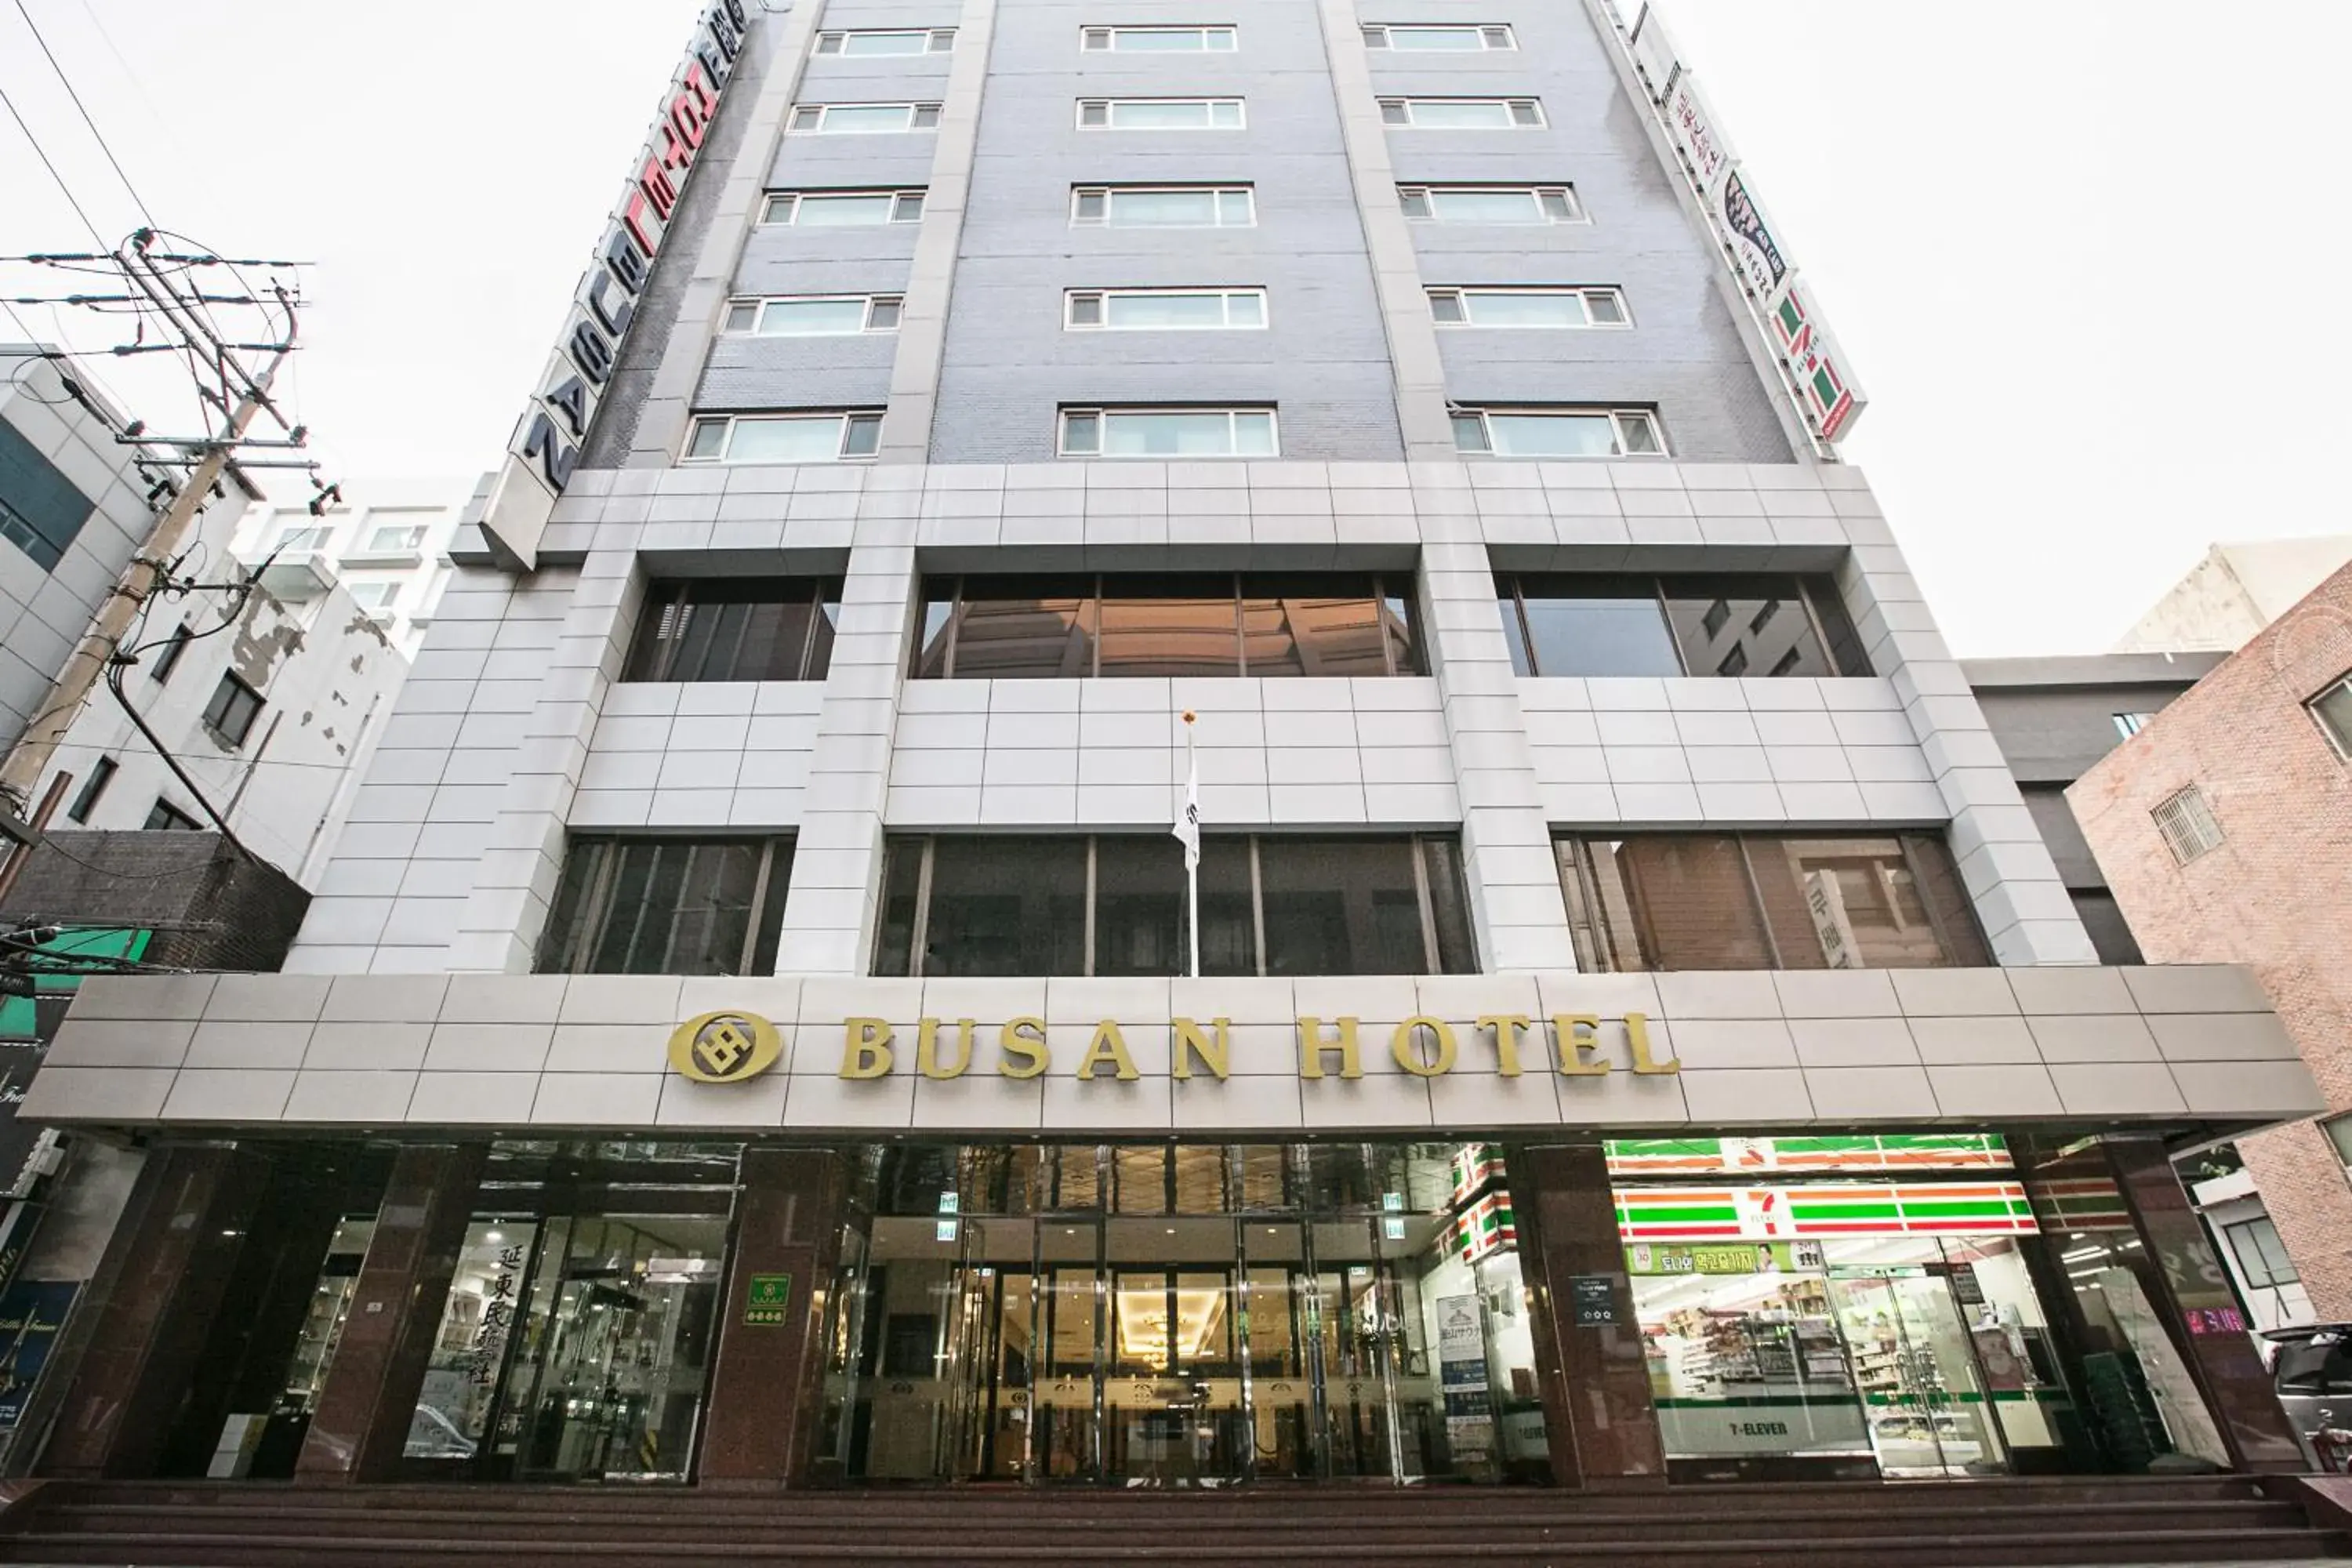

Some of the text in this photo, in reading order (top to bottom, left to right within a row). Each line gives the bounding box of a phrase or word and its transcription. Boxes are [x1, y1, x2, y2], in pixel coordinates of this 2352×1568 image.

[524, 61, 719, 492] HOTEL BUSAN
[838, 1013, 1681, 1080] BUSAN HOTEL
